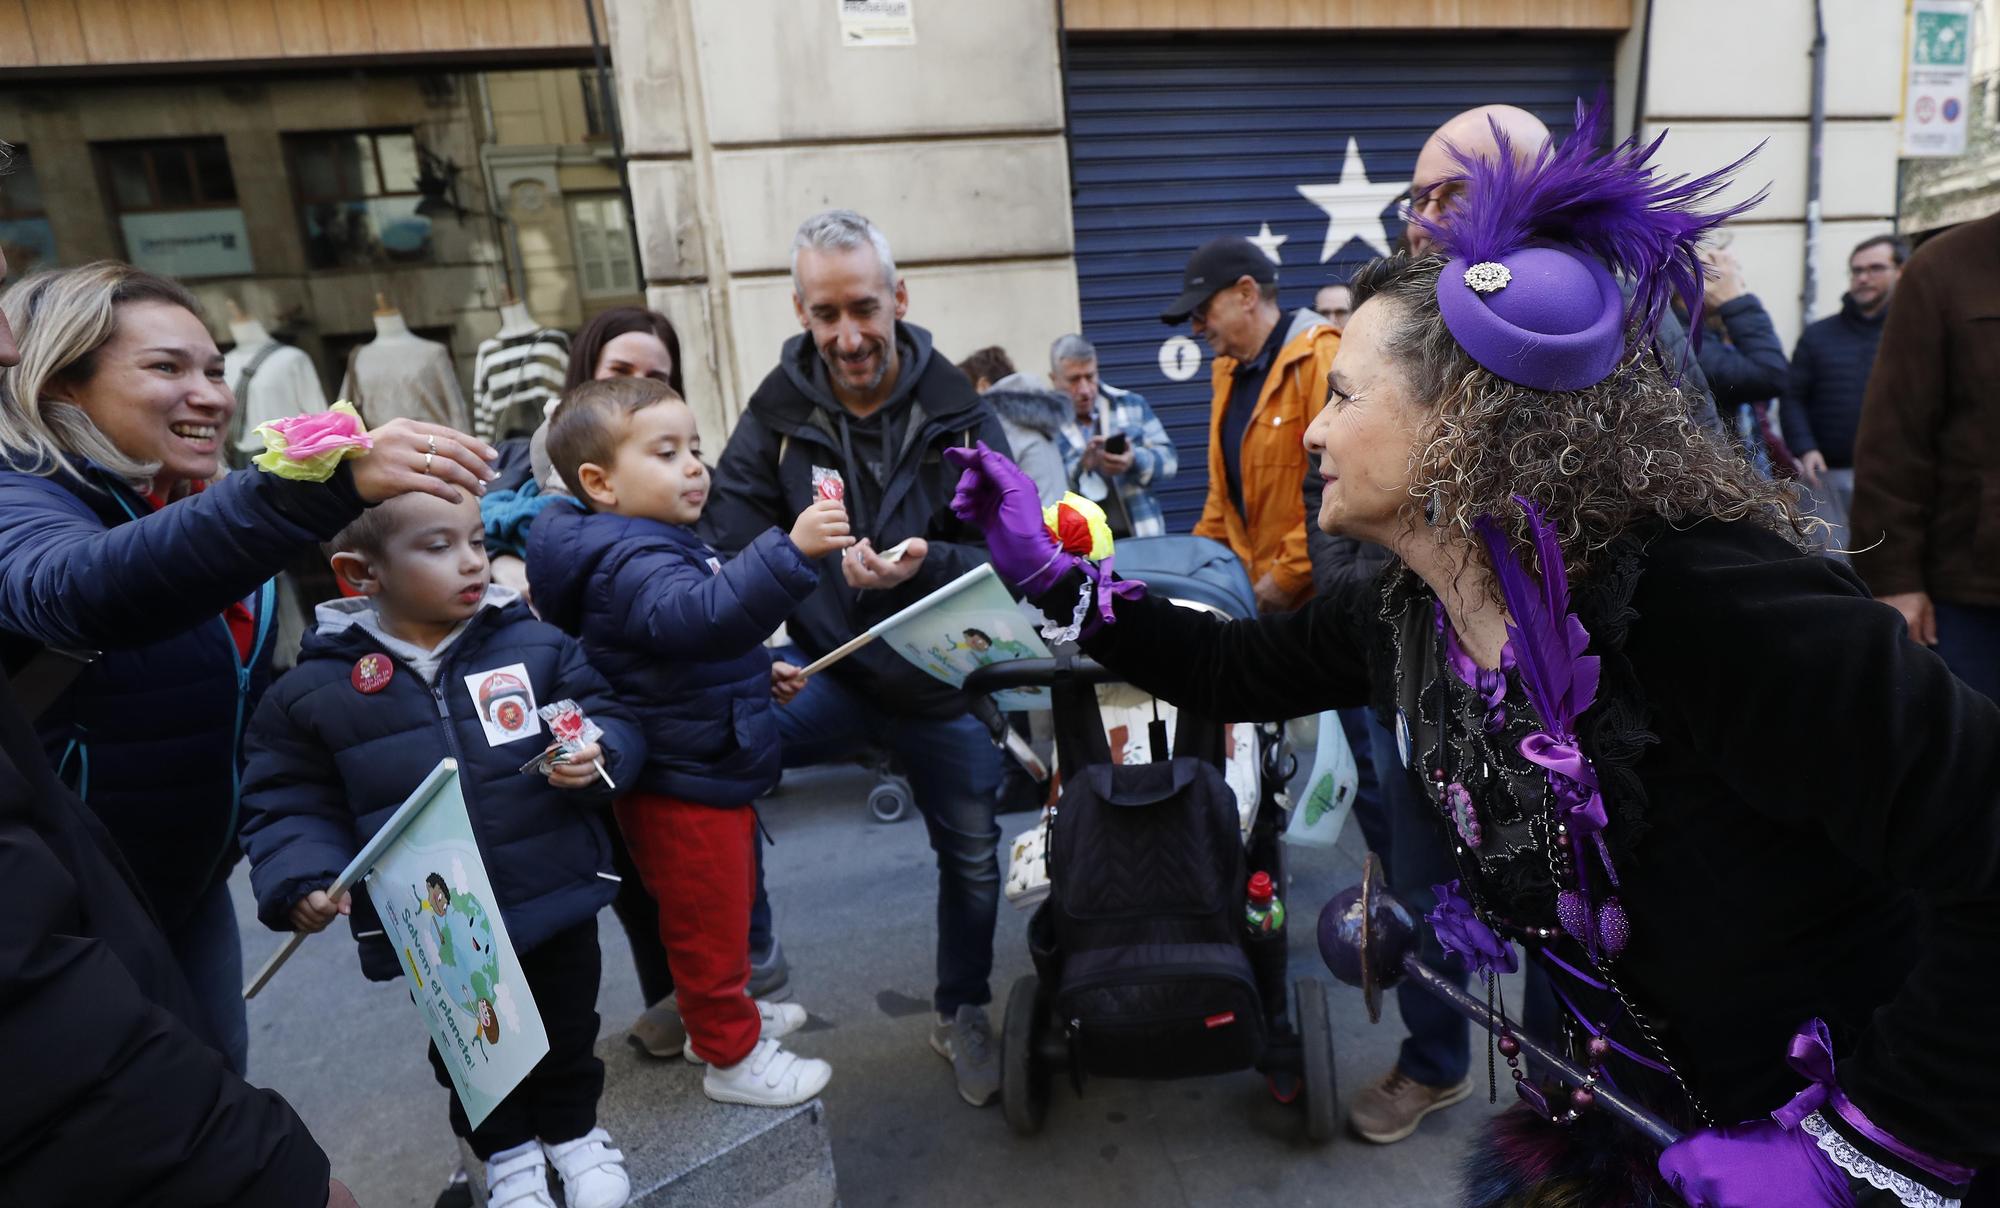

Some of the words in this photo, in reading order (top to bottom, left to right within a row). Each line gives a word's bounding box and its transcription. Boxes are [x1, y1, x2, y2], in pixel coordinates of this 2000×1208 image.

[402, 908, 431, 976] Salvem
[431, 980, 442, 996] el
[438, 999, 475, 1071] planeta!
